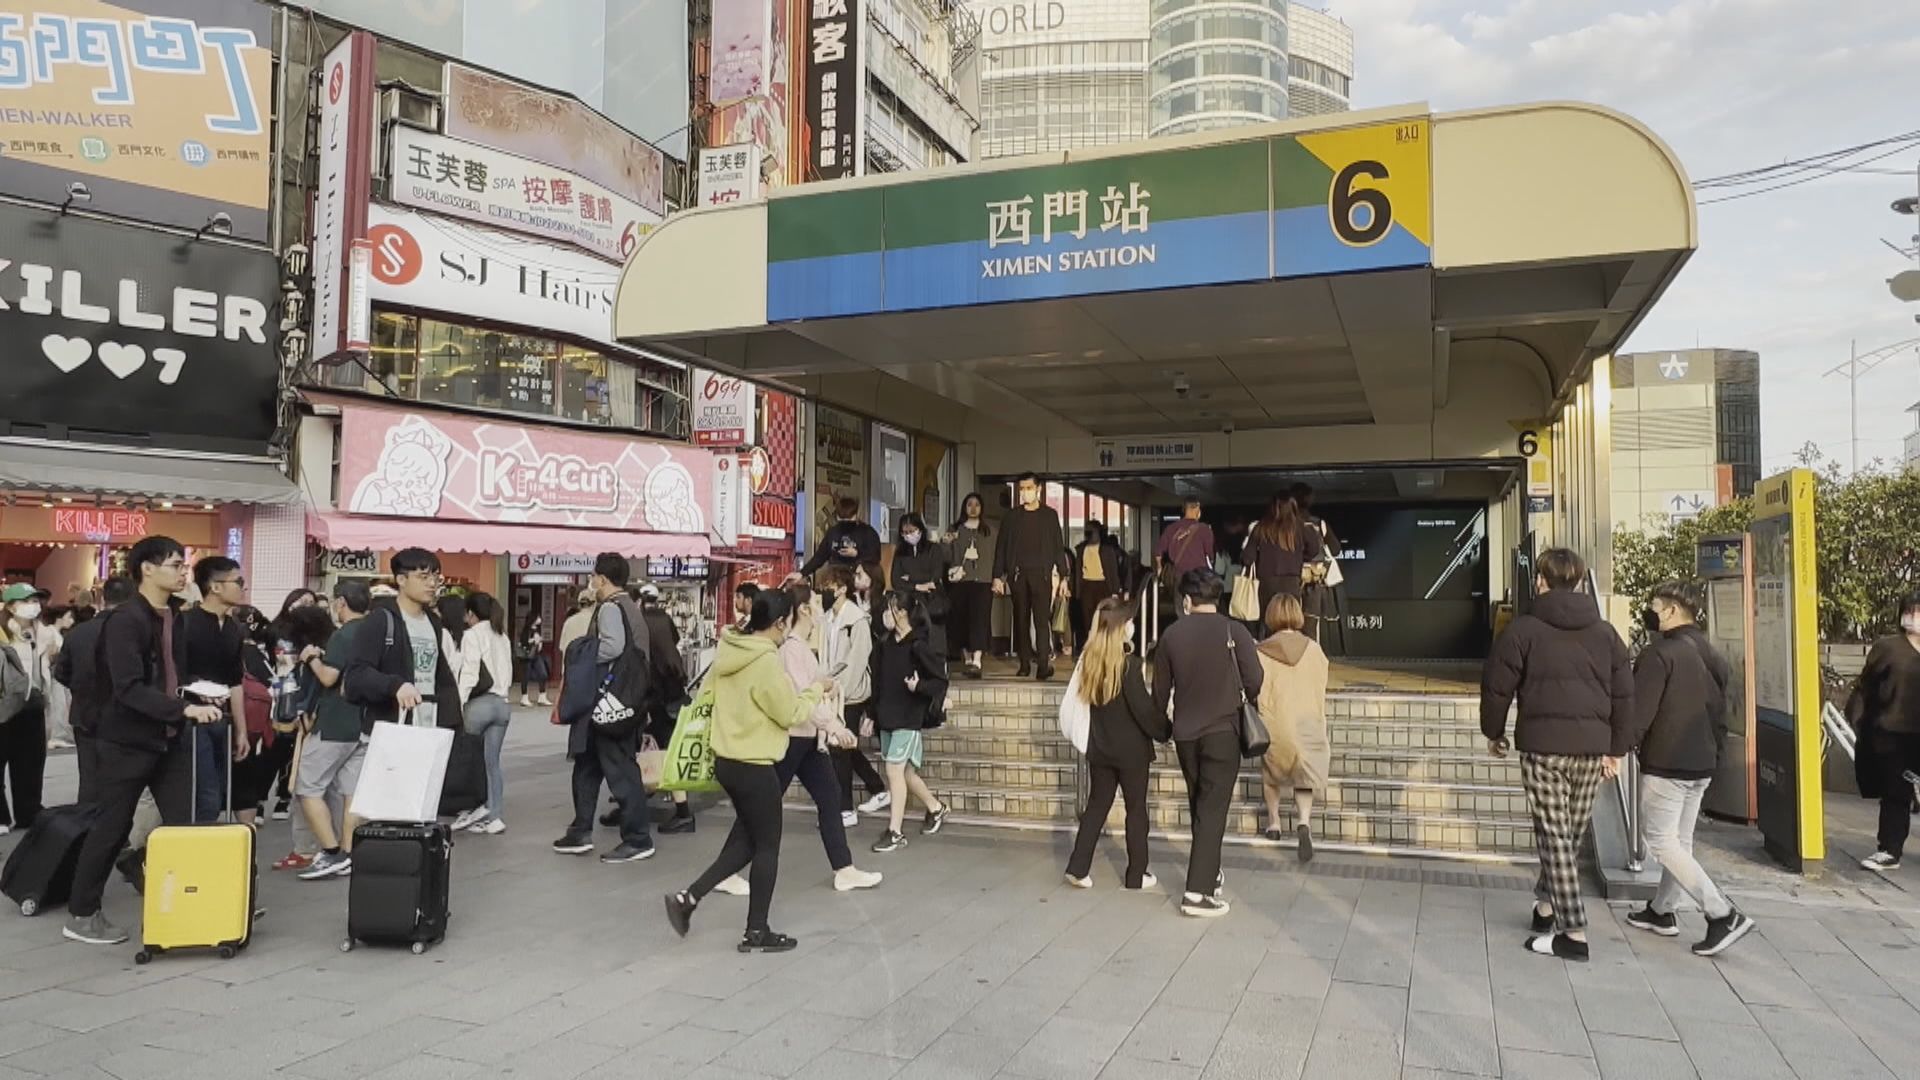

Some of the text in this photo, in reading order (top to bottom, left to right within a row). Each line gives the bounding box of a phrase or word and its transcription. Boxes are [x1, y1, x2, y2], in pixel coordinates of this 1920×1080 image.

[0, 108, 133, 128] EN-WALKER
[1396, 125, 1419, 141] 出入口
[117, 144, 166, 158] 西門文化
[407, 144, 488, 193] 玉芙蓉
[493, 177, 516, 190] SPA
[522, 175, 575, 206] 按摩
[986, 182, 1151, 249] 西門站
[1331, 160, 1392, 245] 6
[982, 243, 1156, 279] XIMEN STATION
[152, 348, 187, 385] 7
[1519, 430, 1538, 457] 6
[56, 511, 146, 536] KILLER
[331, 552, 375, 570] 4Cut
